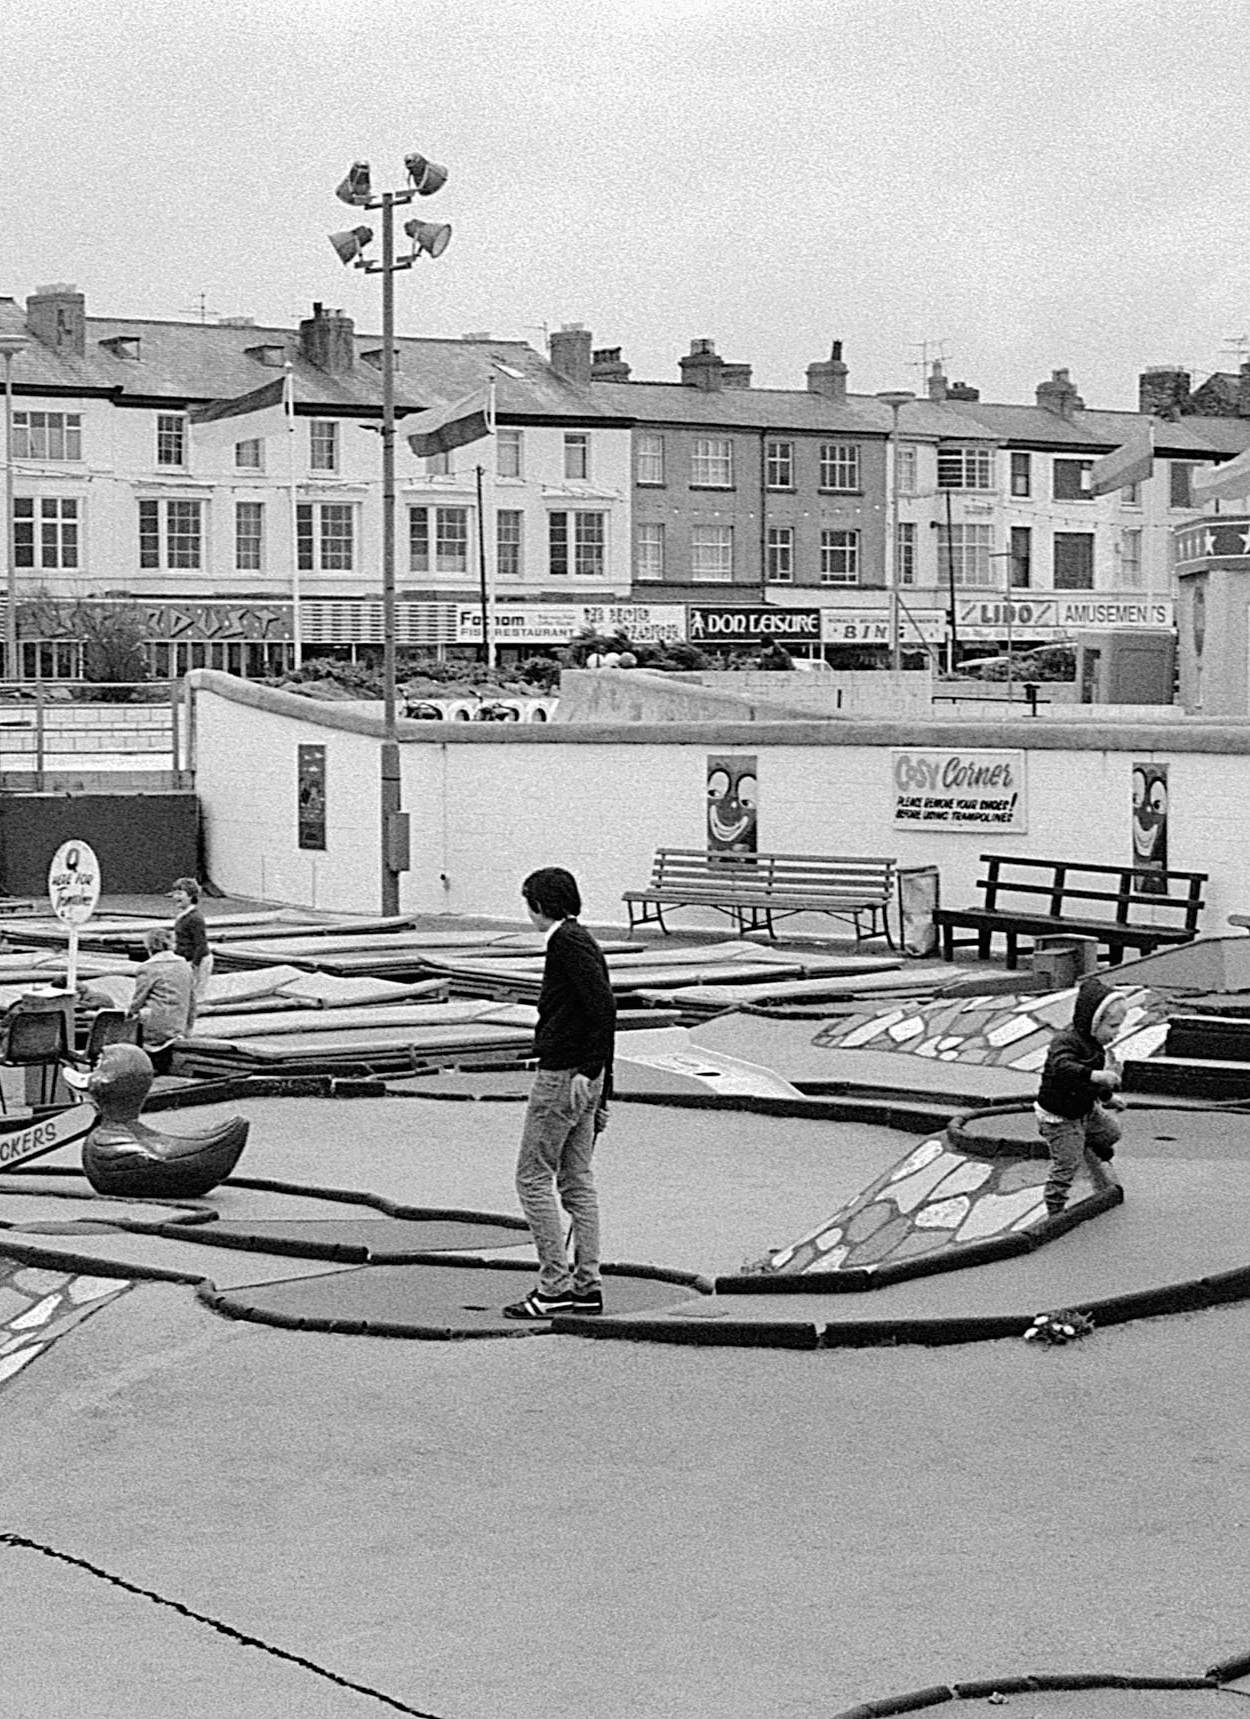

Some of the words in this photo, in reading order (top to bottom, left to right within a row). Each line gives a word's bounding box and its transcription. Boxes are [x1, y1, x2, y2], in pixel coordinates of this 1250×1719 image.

[980, 604, 1033, 624] LIDO
[1065, 605, 1166, 623] AMUSEMENTS
[942, 756, 1012, 789] Corner
[66, 847, 79, 873] Q
